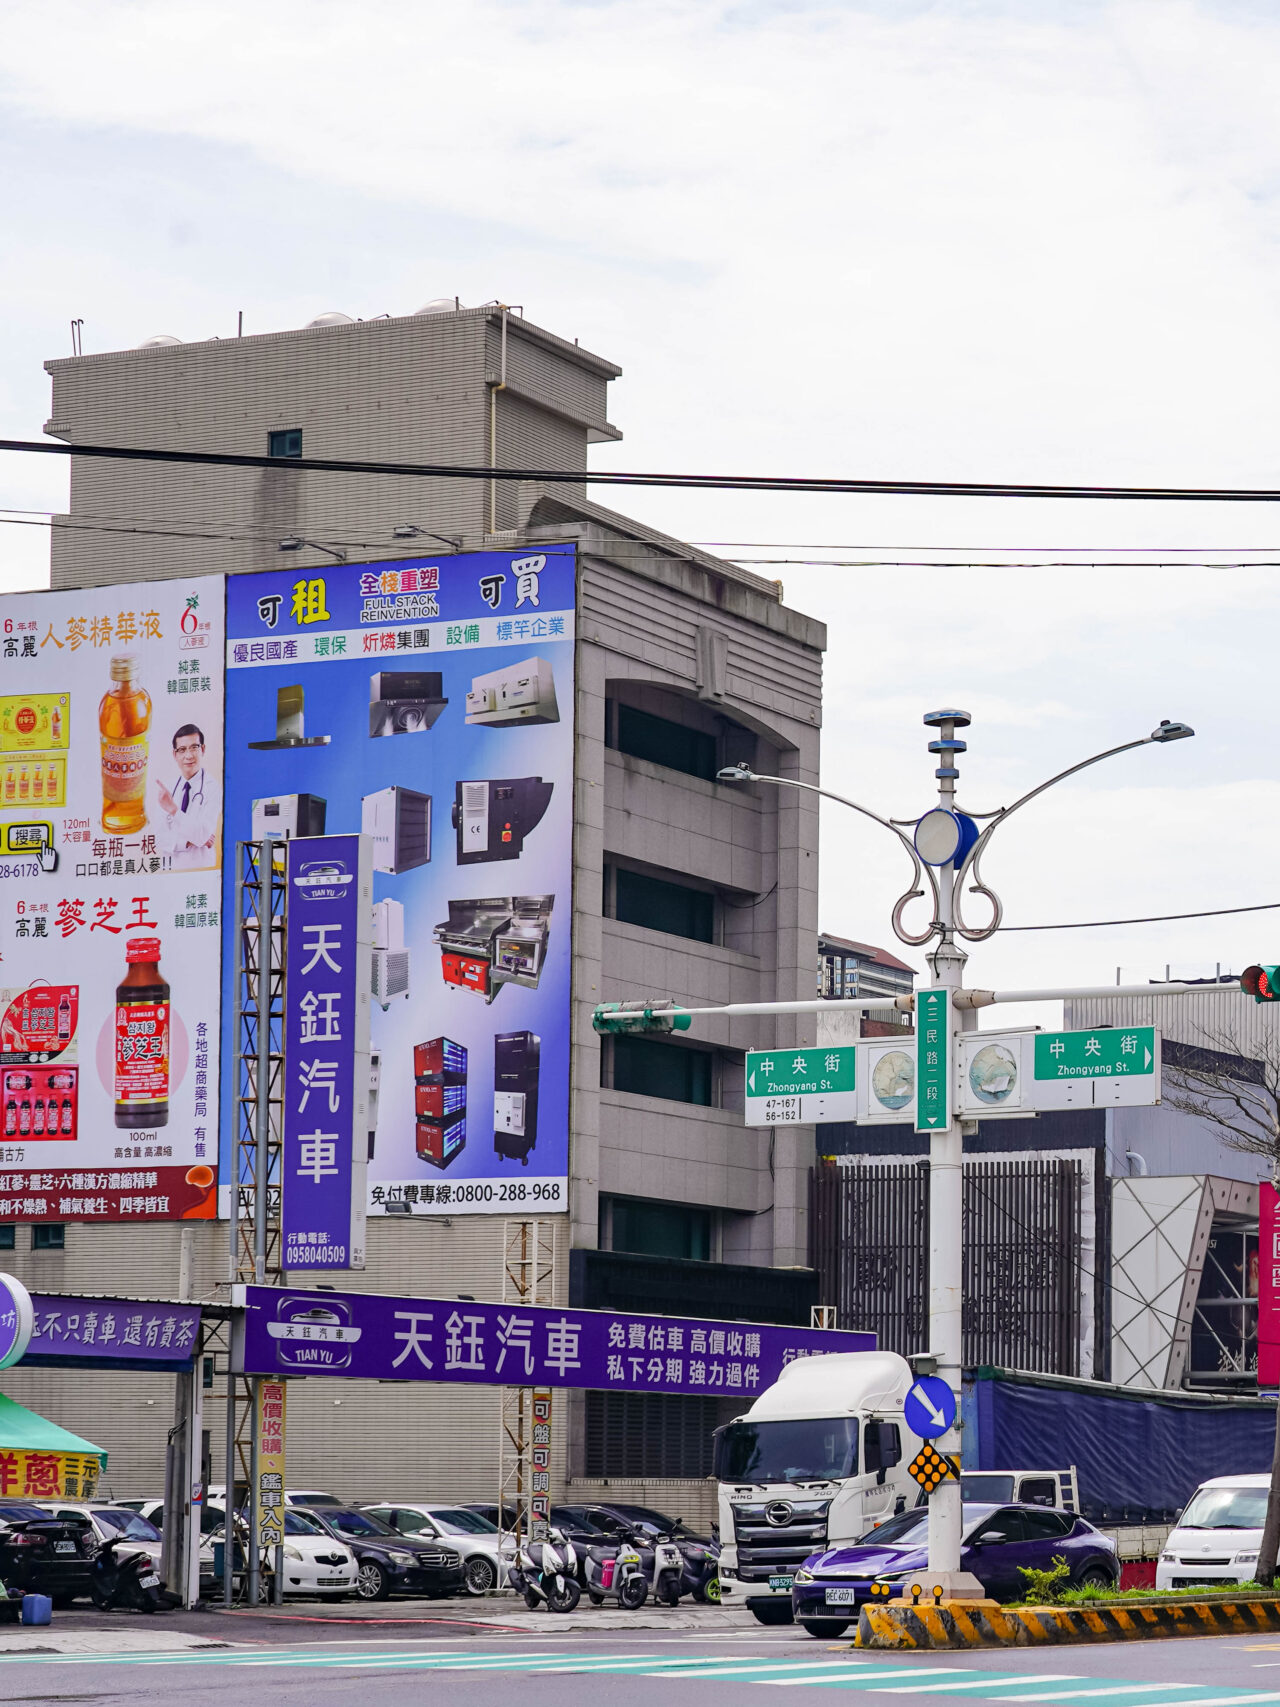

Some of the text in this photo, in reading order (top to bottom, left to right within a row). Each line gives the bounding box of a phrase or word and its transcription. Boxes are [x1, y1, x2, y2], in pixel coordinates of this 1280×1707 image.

[480, 555, 547, 609] 可買
[259, 578, 331, 629] 可租
[366, 594, 435, 610] FULL STACK
[362, 606, 438, 621] REINVENTION
[3, 635, 38, 658] 高麗
[233, 640, 298, 663] 優良國產
[314, 635, 347, 656] 環保
[446, 624, 480, 645] 設備
[497, 616, 564, 641] 標竿企業
[178, 659, 200, 675] 純素
[167, 677, 211, 695] 韓國原裝
[63, 818, 90, 830] 120ml
[16, 829, 43, 846] 搜尋
[62, 831, 91, 843] 大容量
[92, 834, 157, 858] 每瓶一根
[186, 893, 208, 909] 純素
[312, 889, 326, 897] TIAN
[54, 897, 158, 938] 蔘芝王
[174, 912, 219, 929] 韓國原裝
[16, 917, 48, 938] 高麗
[297, 924, 342, 1184] 天鈺汽車
[1050, 1035, 1138, 1059] 中央街
[760, 1054, 840, 1077] 中央街
[1057, 1062, 1130, 1076] Zhongyang St.
[194, 1022, 208, 1157] 各地超商藥局 有售
[767, 1080, 833, 1093] Zhongyang St.
[766, 1099, 796, 1108] 47-167
[766, 1111, 796, 1121] 56-152
[129, 1132, 157, 1142] 100ml
[114, 1148, 142, 1158] 高含量
[286, 1245, 346, 1264] 0958040509
[392, 1311, 582, 1377] 天鈺汽車
[608, 1322, 760, 1358] 免費估車 高價收購
[295, 1349, 333, 1364] TIAN YU
[607, 1354, 760, 1388] 私下分期 強力過件
